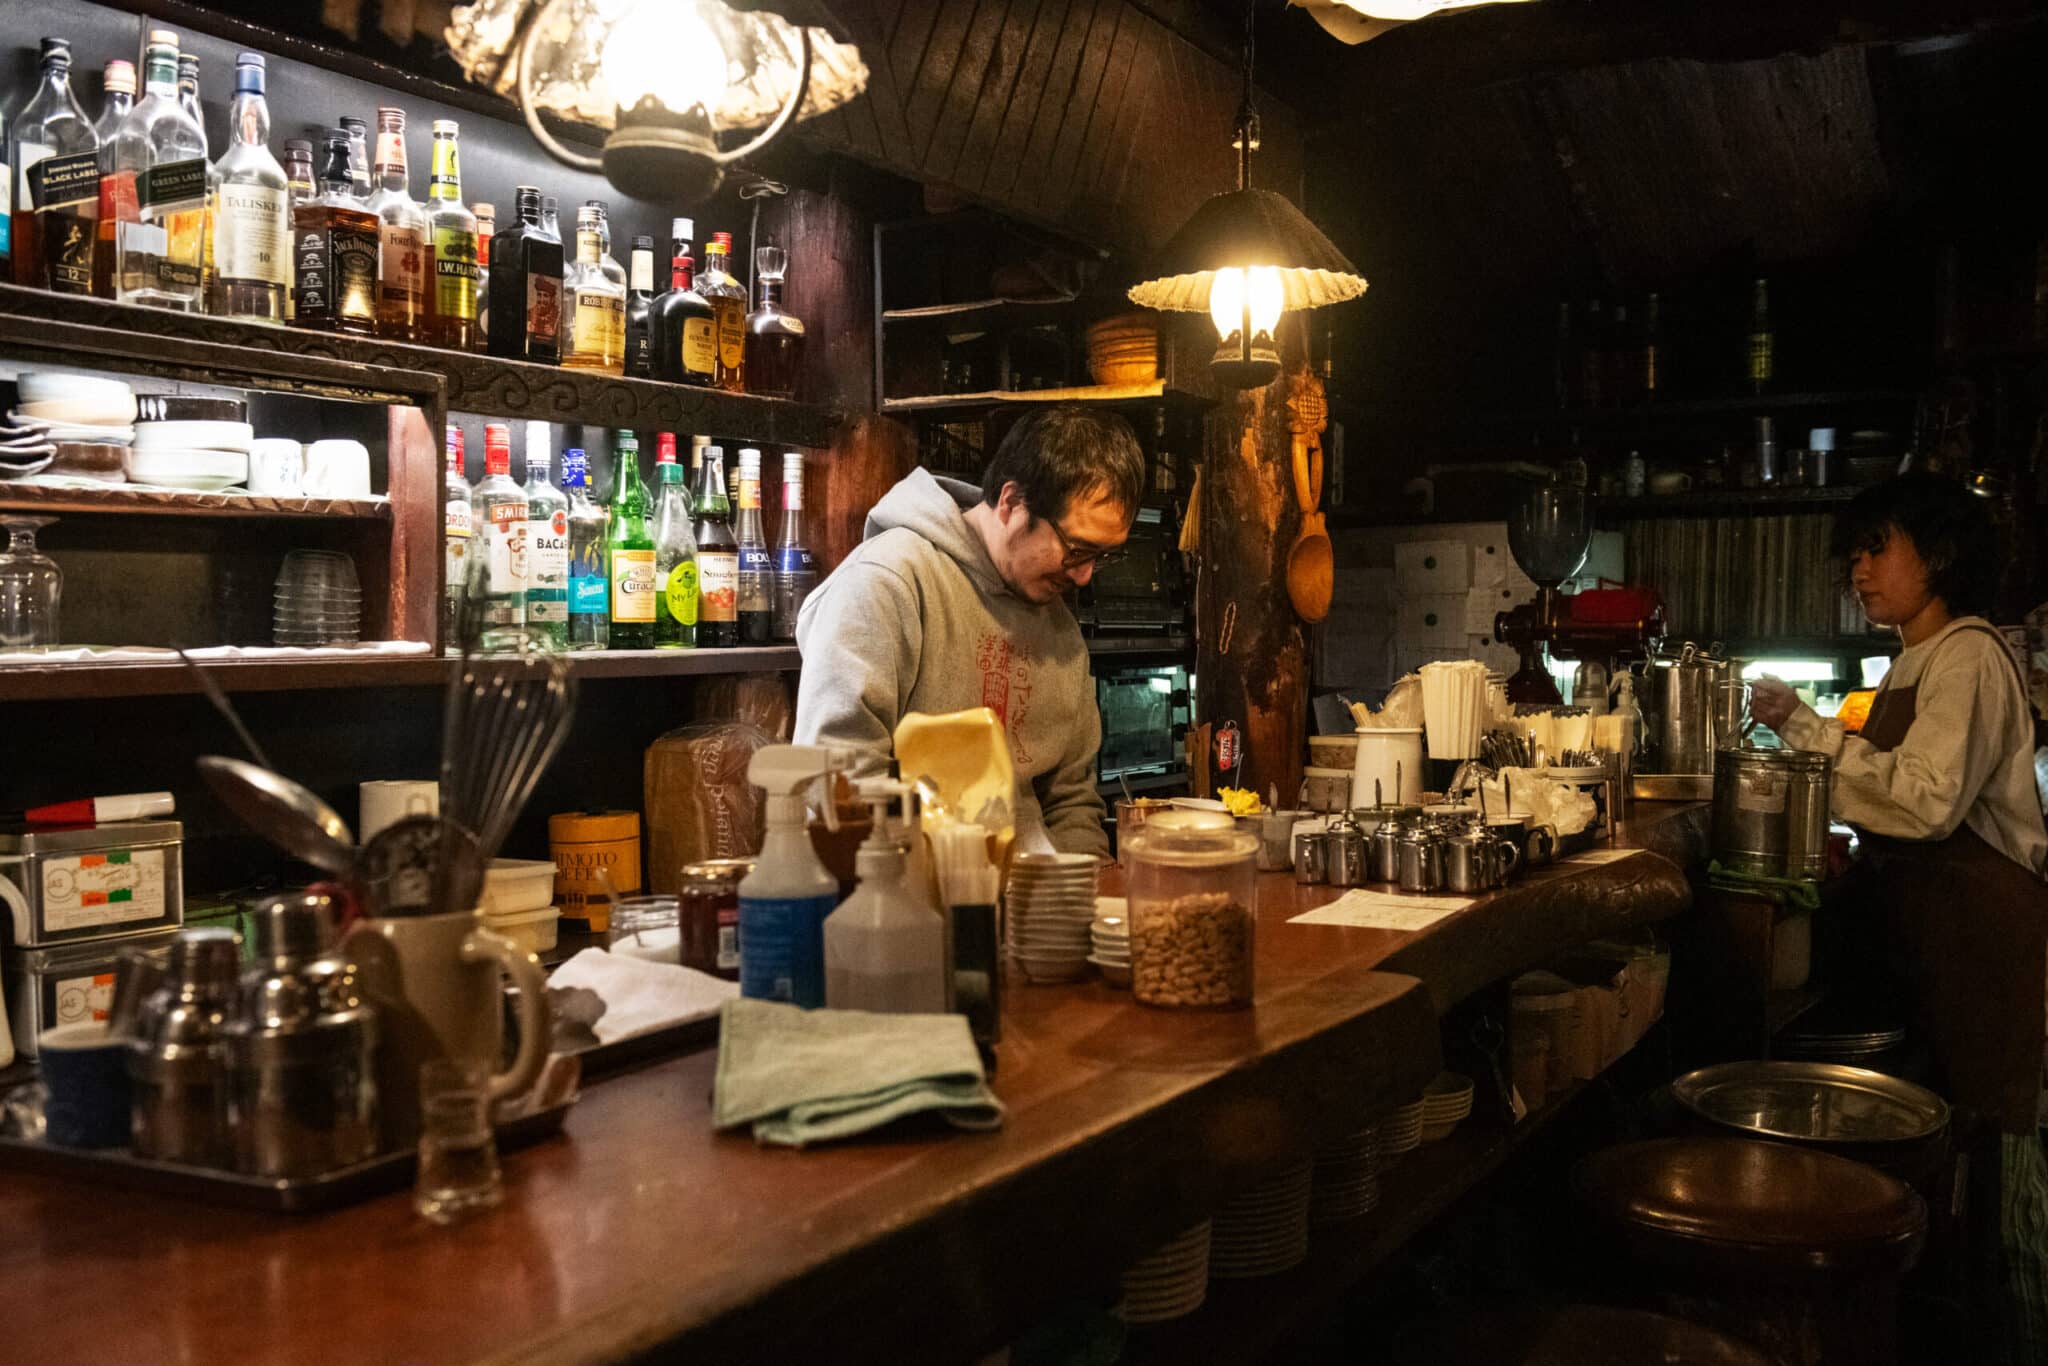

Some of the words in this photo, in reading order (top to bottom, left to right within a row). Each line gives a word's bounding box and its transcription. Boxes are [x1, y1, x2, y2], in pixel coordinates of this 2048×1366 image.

[42, 174, 72, 184] BLACK
[68, 269, 79, 280] 12
[537, 538, 567, 549] BACA
[746, 553, 770, 563] BOL
